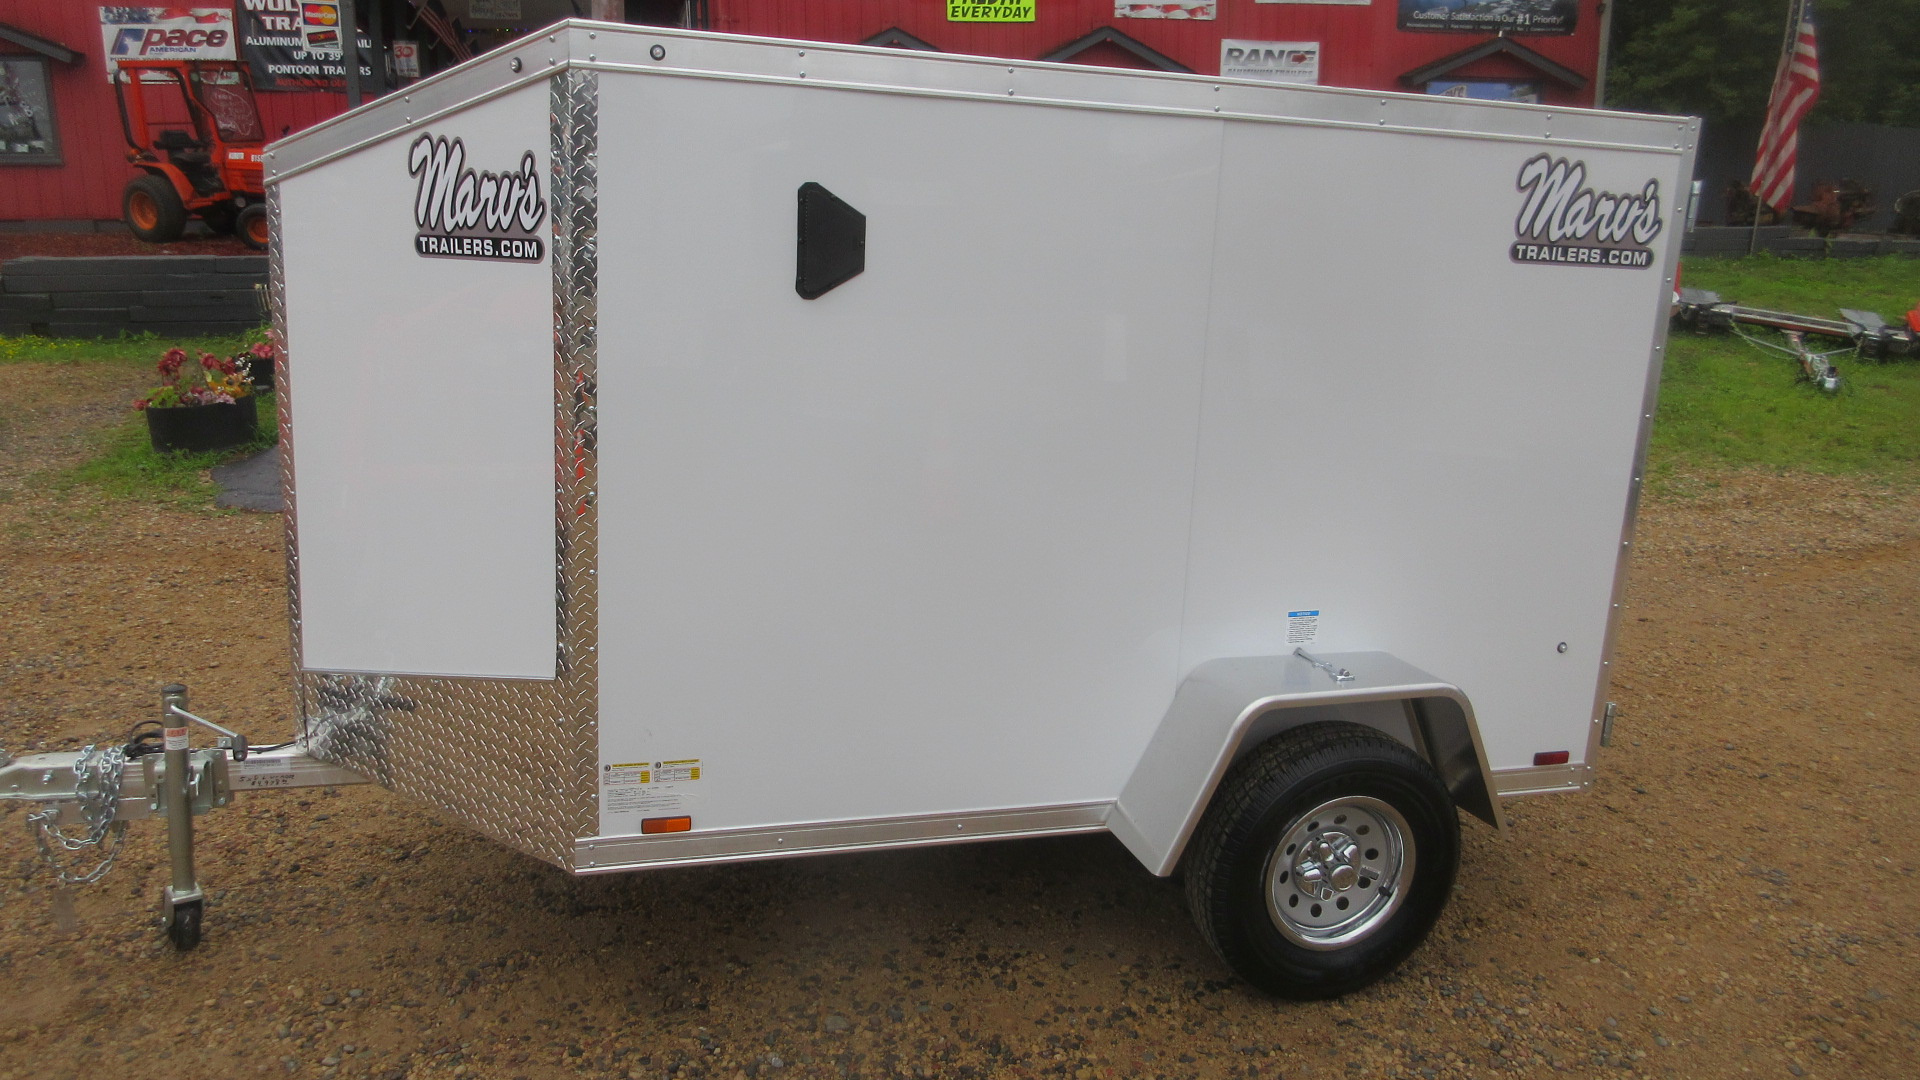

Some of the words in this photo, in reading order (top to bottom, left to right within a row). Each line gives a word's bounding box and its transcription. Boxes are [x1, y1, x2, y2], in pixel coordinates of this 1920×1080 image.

[950, 6, 1031, 18] EVERYDAY
[1413, 10, 1449, 21] Customer
[1451, 12, 1494, 22] Satisfaction
[1502, 14, 1515, 22] Our
[1516, 13, 1530, 25] #1
[139, 29, 228, 55] pace
[246, 36, 303, 47] ALUMINUM
[293, 51, 308, 60] UP
[312, 52, 325, 61] TO
[268, 65, 319, 75] PONTOON
[410, 134, 545, 234] Marv's
[1517, 154, 1661, 244] Marv's
[419, 236, 538, 258] TRAILERS.COM
[1516, 245, 1647, 266] TRAILERS.COM
